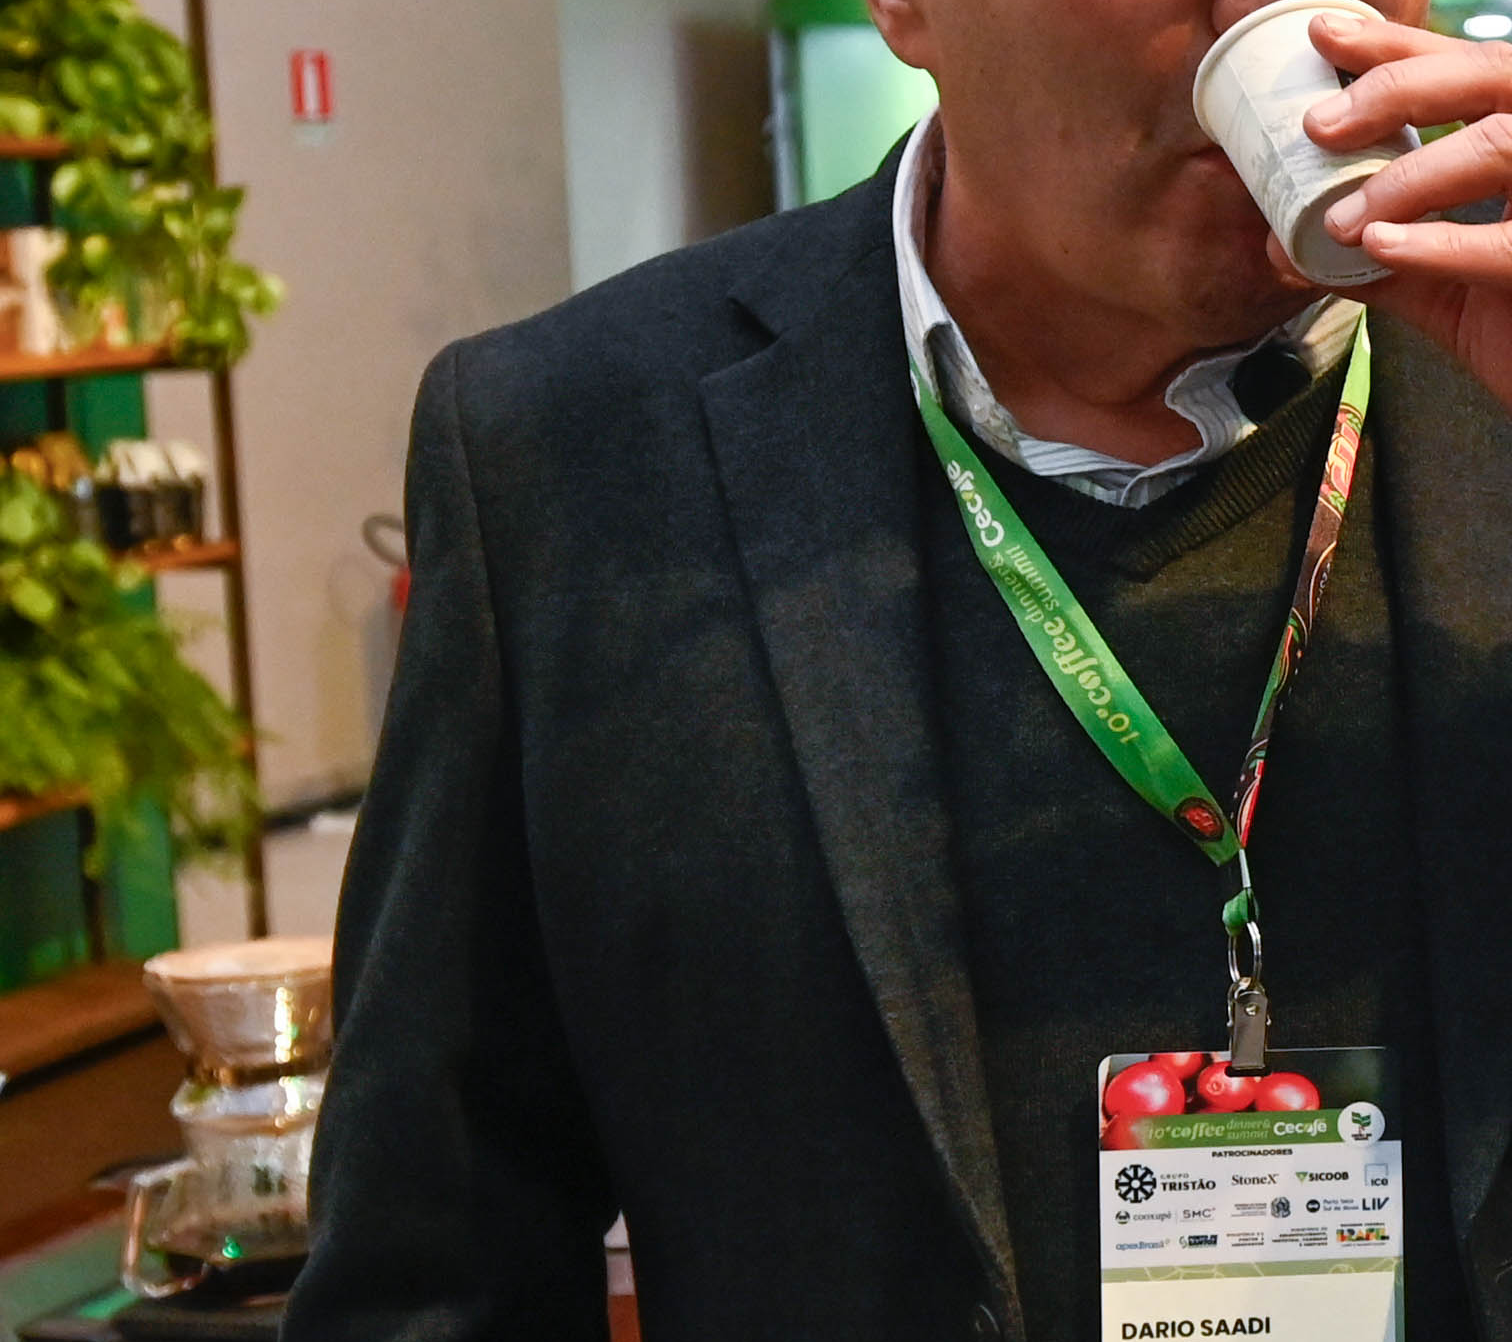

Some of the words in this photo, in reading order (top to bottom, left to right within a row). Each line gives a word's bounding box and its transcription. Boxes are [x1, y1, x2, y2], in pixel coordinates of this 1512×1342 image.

[1211, 1148, 1293, 1158] PATROCINADORES
[1161, 1178, 1217, 1192] TRISTÃO
[1231, 1173, 1278, 1186] StoneX
[1308, 1171, 1350, 1182] SICOOB
[1362, 1196, 1390, 1211] LIV
[1182, 1208, 1213, 1219] SMC
[1121, 1320, 1195, 1341] DARIO
[1200, 1316, 1271, 1337] SAADI
